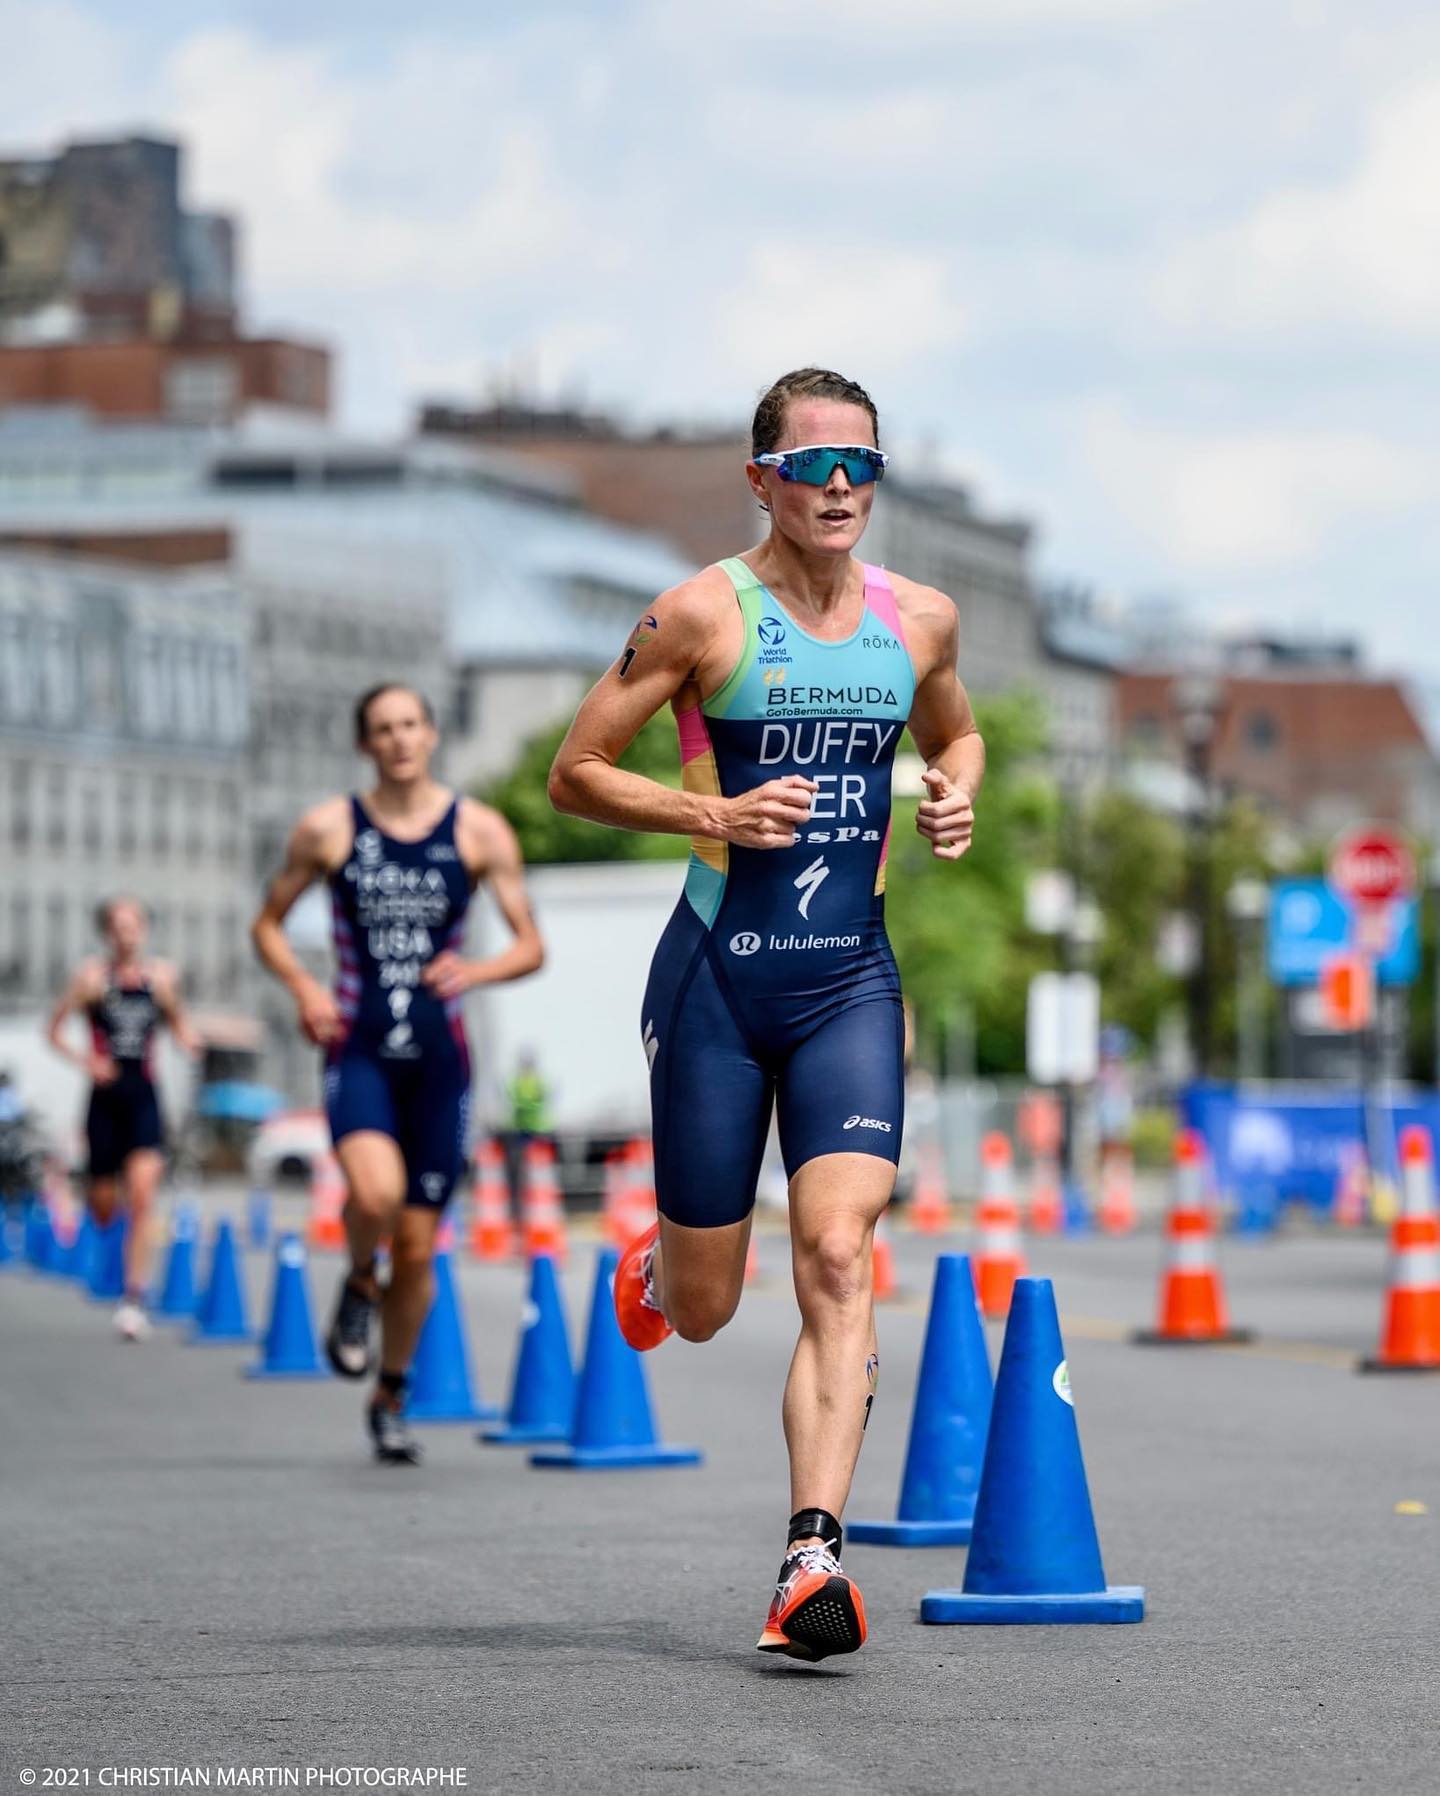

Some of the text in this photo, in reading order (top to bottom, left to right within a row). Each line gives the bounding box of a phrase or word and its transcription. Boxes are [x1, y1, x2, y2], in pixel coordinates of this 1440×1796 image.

[758, 655, 792, 664] Triathlon
[763, 648, 787, 656] World
[619, 647, 637, 677] 1
[768, 687, 898, 705] BERMUDA
[766, 706, 863, 717] GoToBermuda.com
[759, 721, 896, 765] DUFFY
[781, 774, 867, 818] ER
[769, 934, 860, 950] lululemon
[859, 1118, 892, 1132] asics
